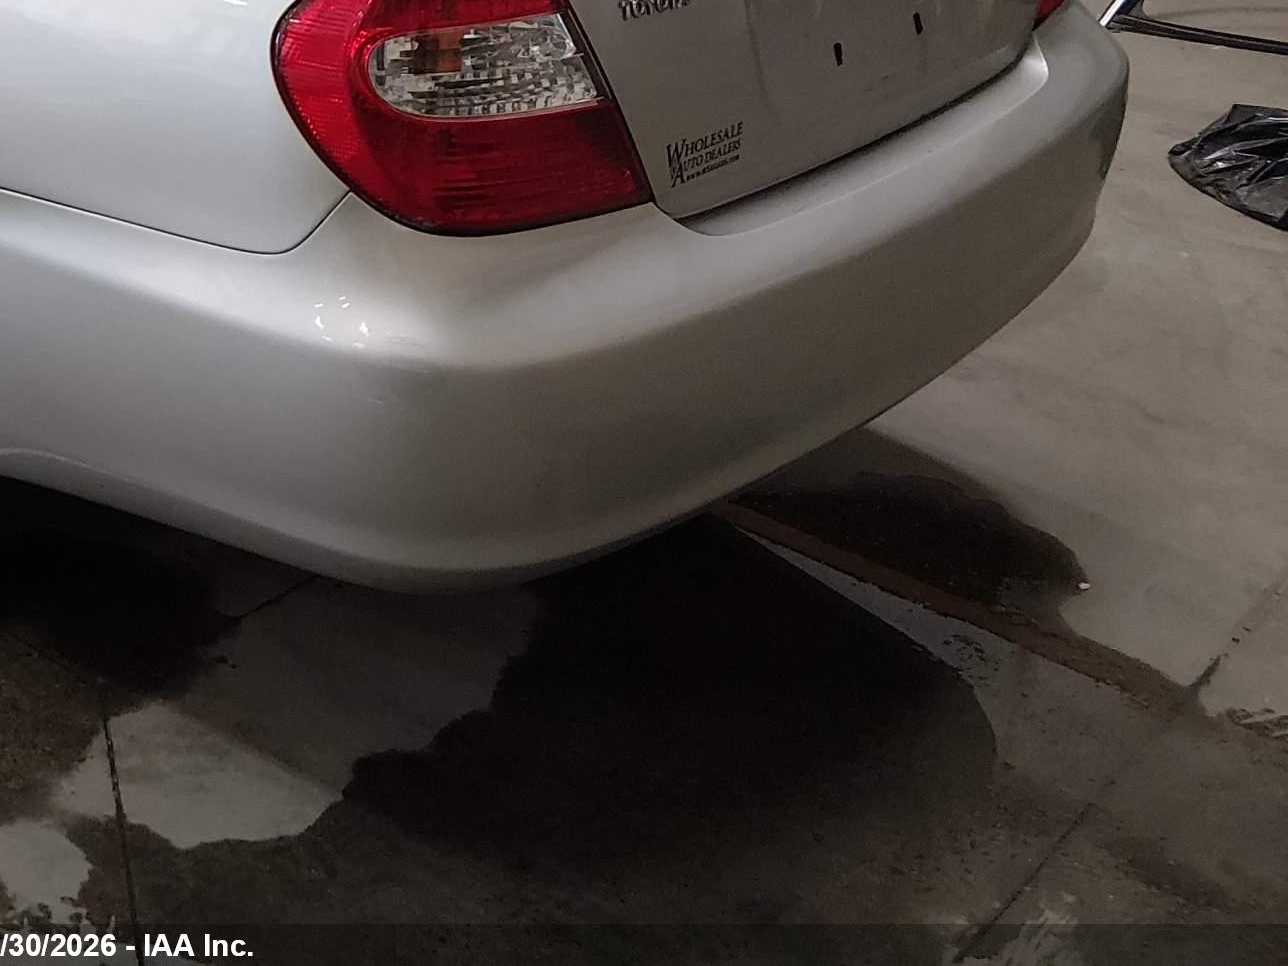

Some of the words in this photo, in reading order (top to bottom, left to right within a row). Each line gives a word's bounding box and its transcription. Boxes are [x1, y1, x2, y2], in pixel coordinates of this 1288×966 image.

[666, 121, 743, 169] WHOLESALE
[671, 154, 704, 188] AUTO
[705, 138, 741, 164] DEALERS
